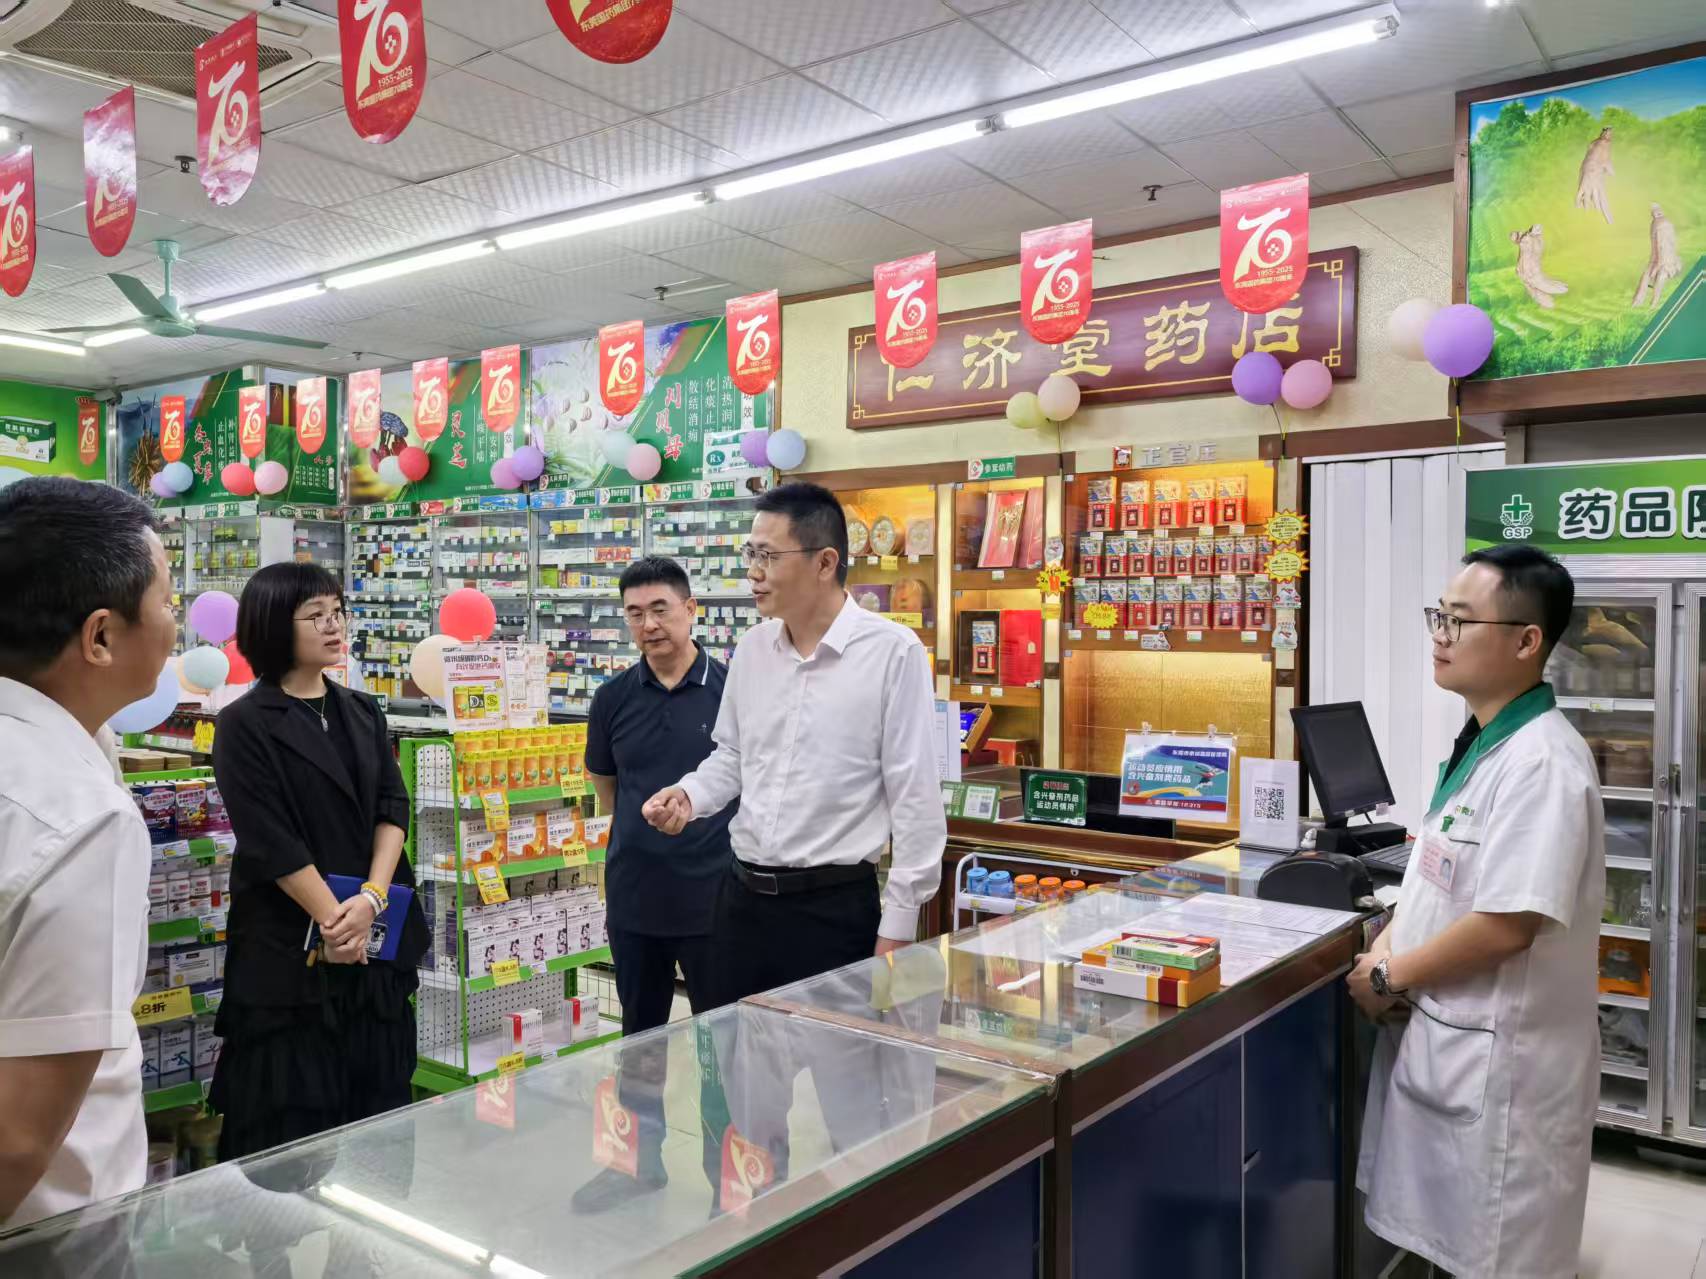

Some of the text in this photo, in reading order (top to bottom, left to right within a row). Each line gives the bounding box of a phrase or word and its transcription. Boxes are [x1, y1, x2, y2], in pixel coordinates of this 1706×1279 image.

[378, 65, 413, 89] 1955-2025
[208, 61, 248, 165] 70
[1233, 207, 1293, 282] 70
[1032, 248, 1080, 315] 70
[1257, 265, 1294, 278] 1955-2025
[886, 279, 927, 341] 70
[736, 313, 770, 371] 70
[606, 341, 637, 394] 70
[418, 376, 442, 419] 70
[488, 364, 514, 411] 70
[743, 394, 753, 418] 效
[243, 401, 262, 440] 70
[301, 396, 321, 434] 70
[353, 387, 376, 429] 70
[656, 382, 683, 461] 川贝母
[81, 416, 96, 449] 70
[164, 410, 181, 446] 70
[448, 410, 467, 469] 灵芝
[1503, 527, 1532, 539] GSP
[1033, 790, 1079, 803] 含兴奋剂药品
[1128, 771, 1191, 784] 含兴奋剂类药品
[1036, 800, 1075, 812] 运动员慎用
[141, 1002, 166, 1015] 8折
